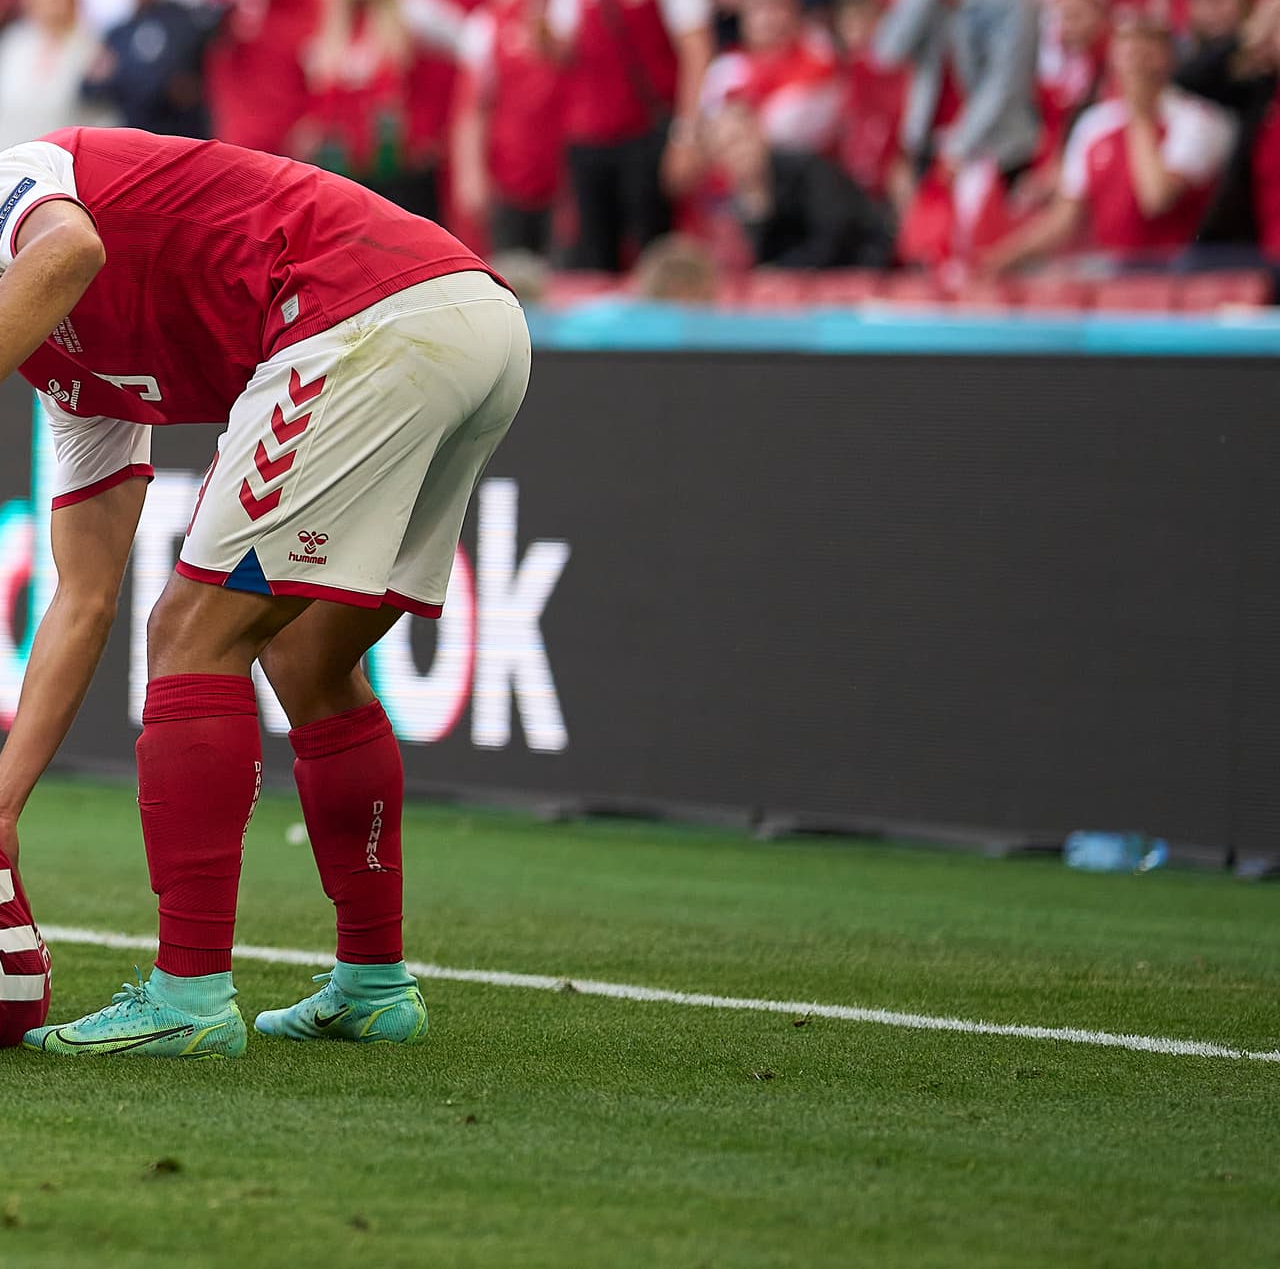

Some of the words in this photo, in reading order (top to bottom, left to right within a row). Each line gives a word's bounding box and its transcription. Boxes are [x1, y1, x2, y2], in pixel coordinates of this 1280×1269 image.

[69, 379, 81, 411] ummel
[288, 551, 328, 565] hummel
[239, 760, 261, 864] DANM
[366, 800, 387, 873] DANMAR
